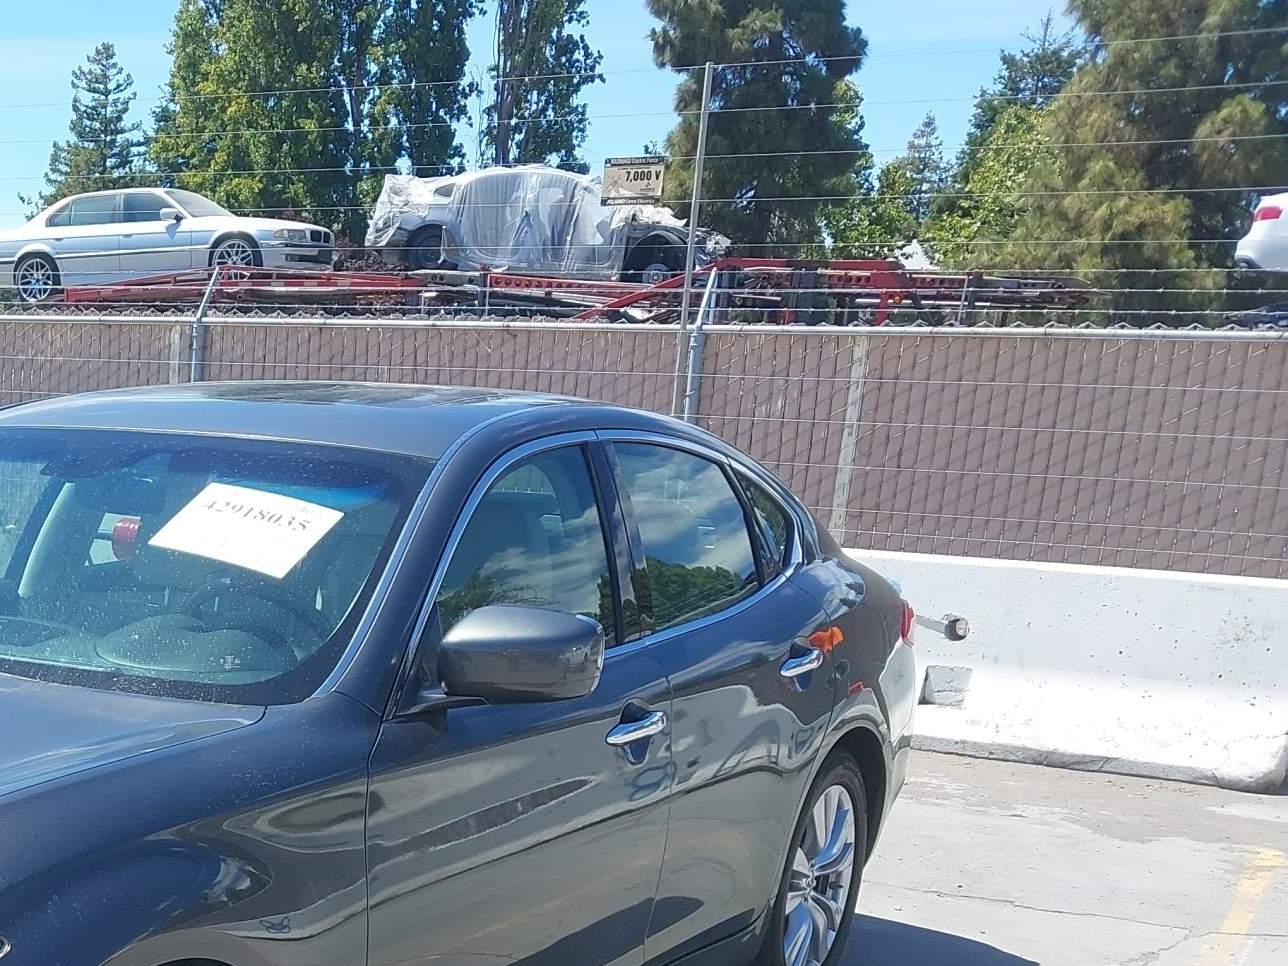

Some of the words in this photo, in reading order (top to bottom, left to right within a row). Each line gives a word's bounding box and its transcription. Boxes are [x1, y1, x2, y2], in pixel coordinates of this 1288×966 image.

[625, 170, 652, 182] 7,000
[655, 170, 661, 180] V
[202, 500, 312, 531] 42918035
